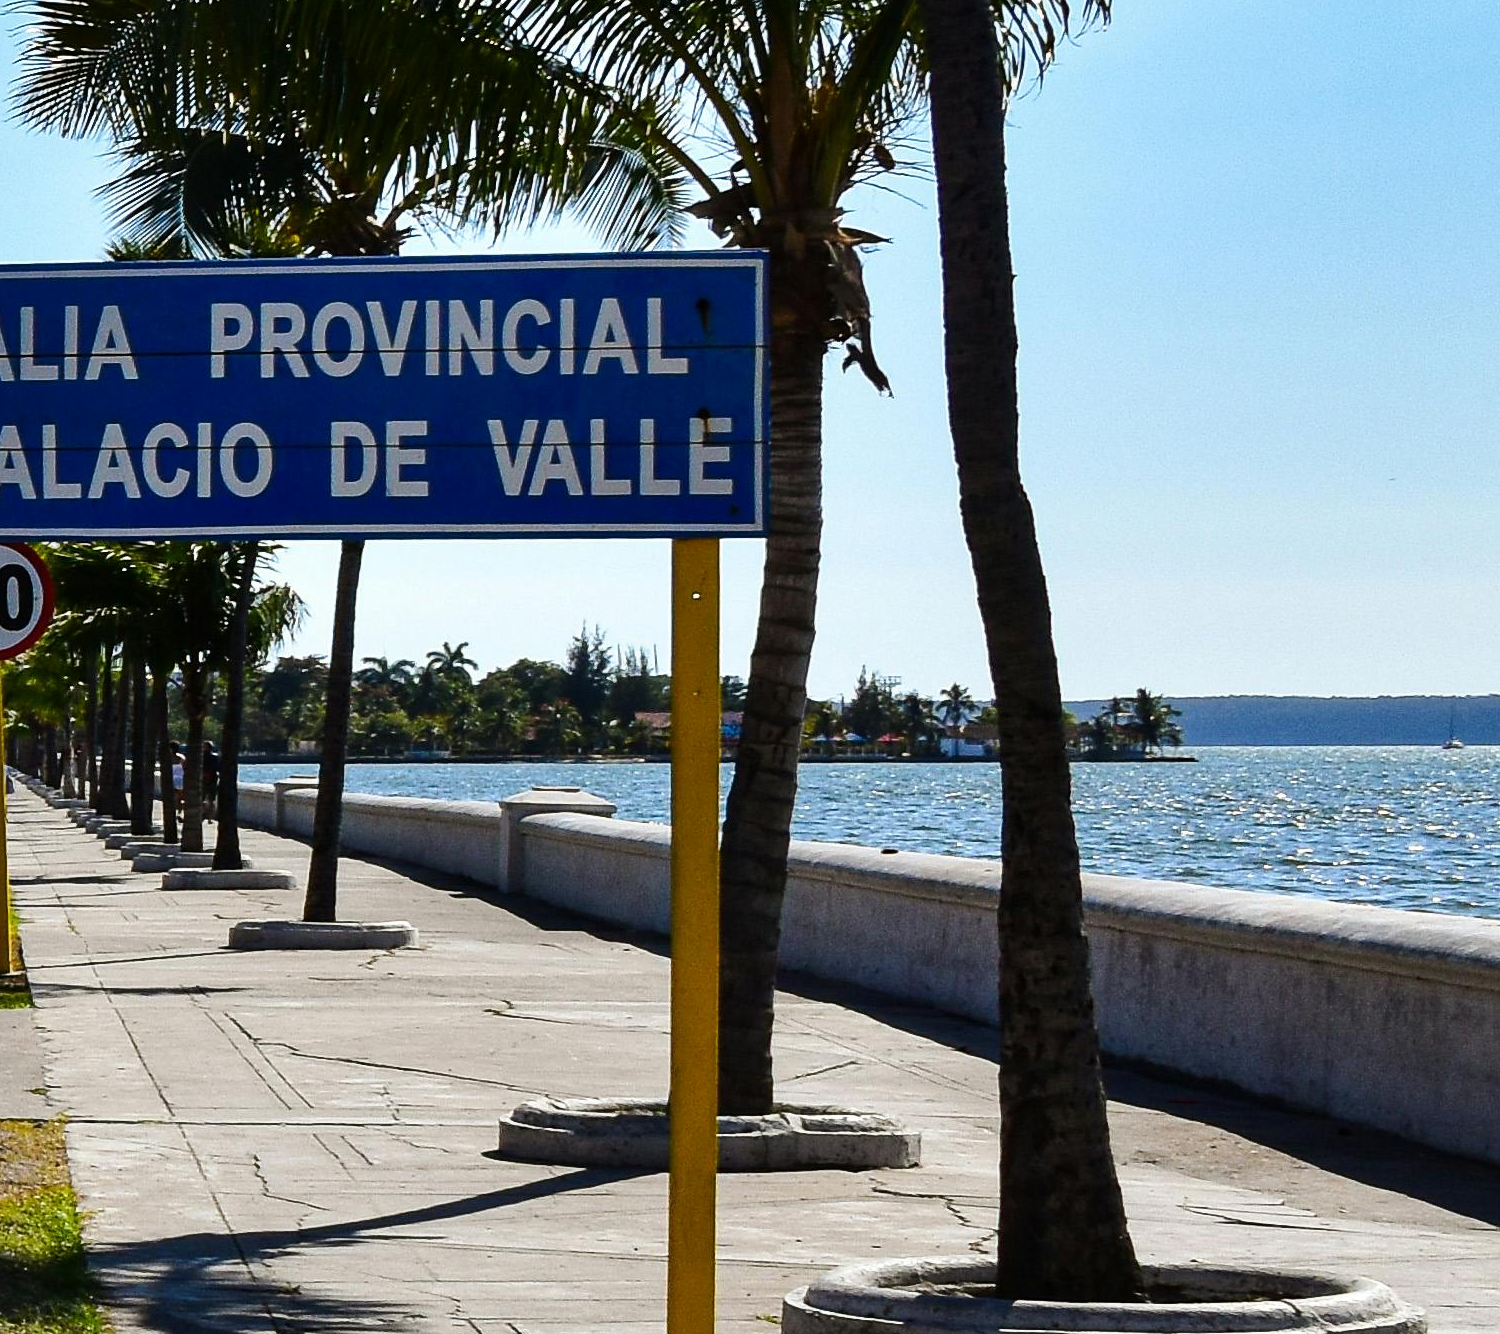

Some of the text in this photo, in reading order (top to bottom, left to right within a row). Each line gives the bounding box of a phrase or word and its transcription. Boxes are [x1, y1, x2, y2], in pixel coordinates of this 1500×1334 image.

[209, 297, 689, 379] PROVINCIAL
[330, 419, 429, 498] DE
[487, 417, 734, 497] VALLE
